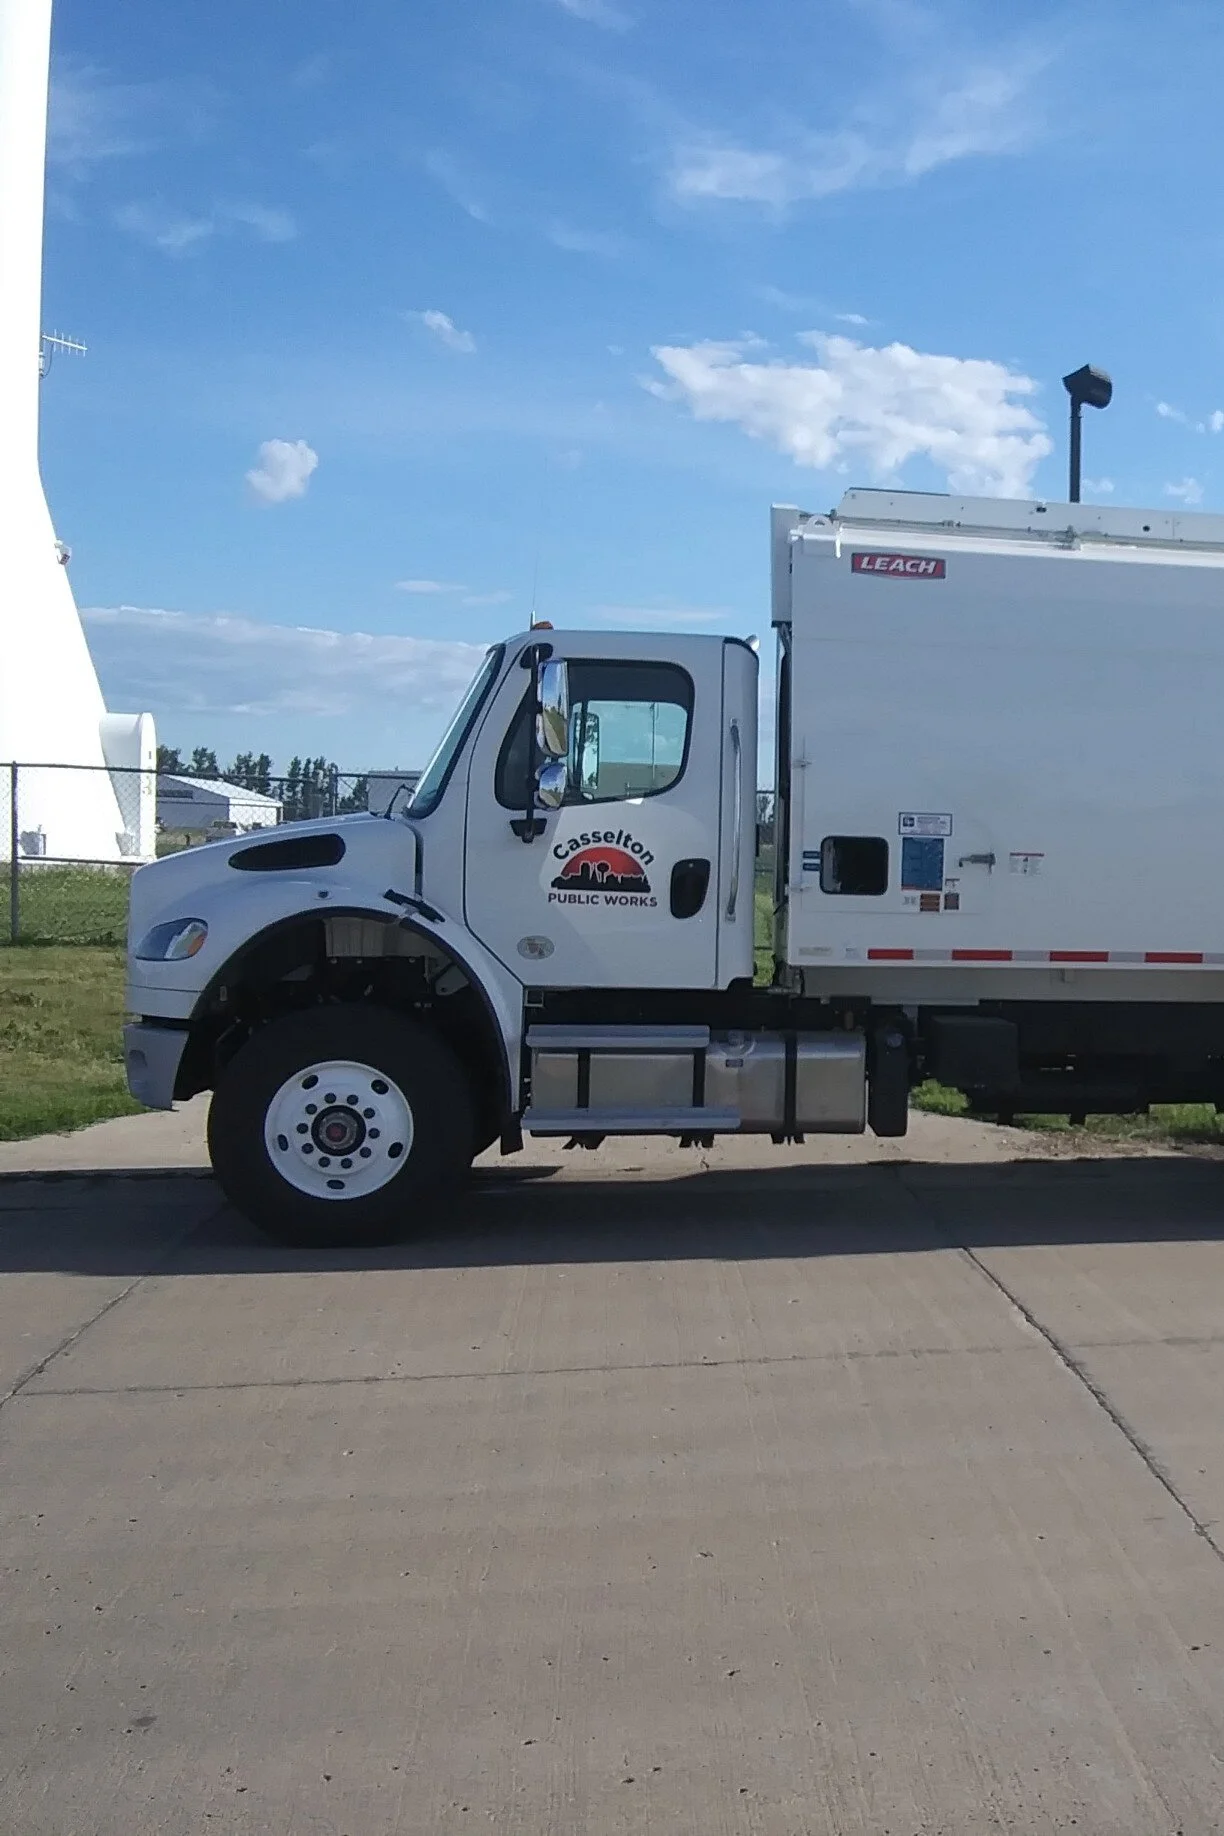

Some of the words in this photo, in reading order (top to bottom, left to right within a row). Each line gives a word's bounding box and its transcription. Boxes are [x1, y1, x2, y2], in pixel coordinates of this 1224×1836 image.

[861, 556, 936, 574] LEACH
[553, 829, 655, 866] Casselton
[548, 892, 600, 905] PUBLIC
[604, 894, 658, 907] WORKS
